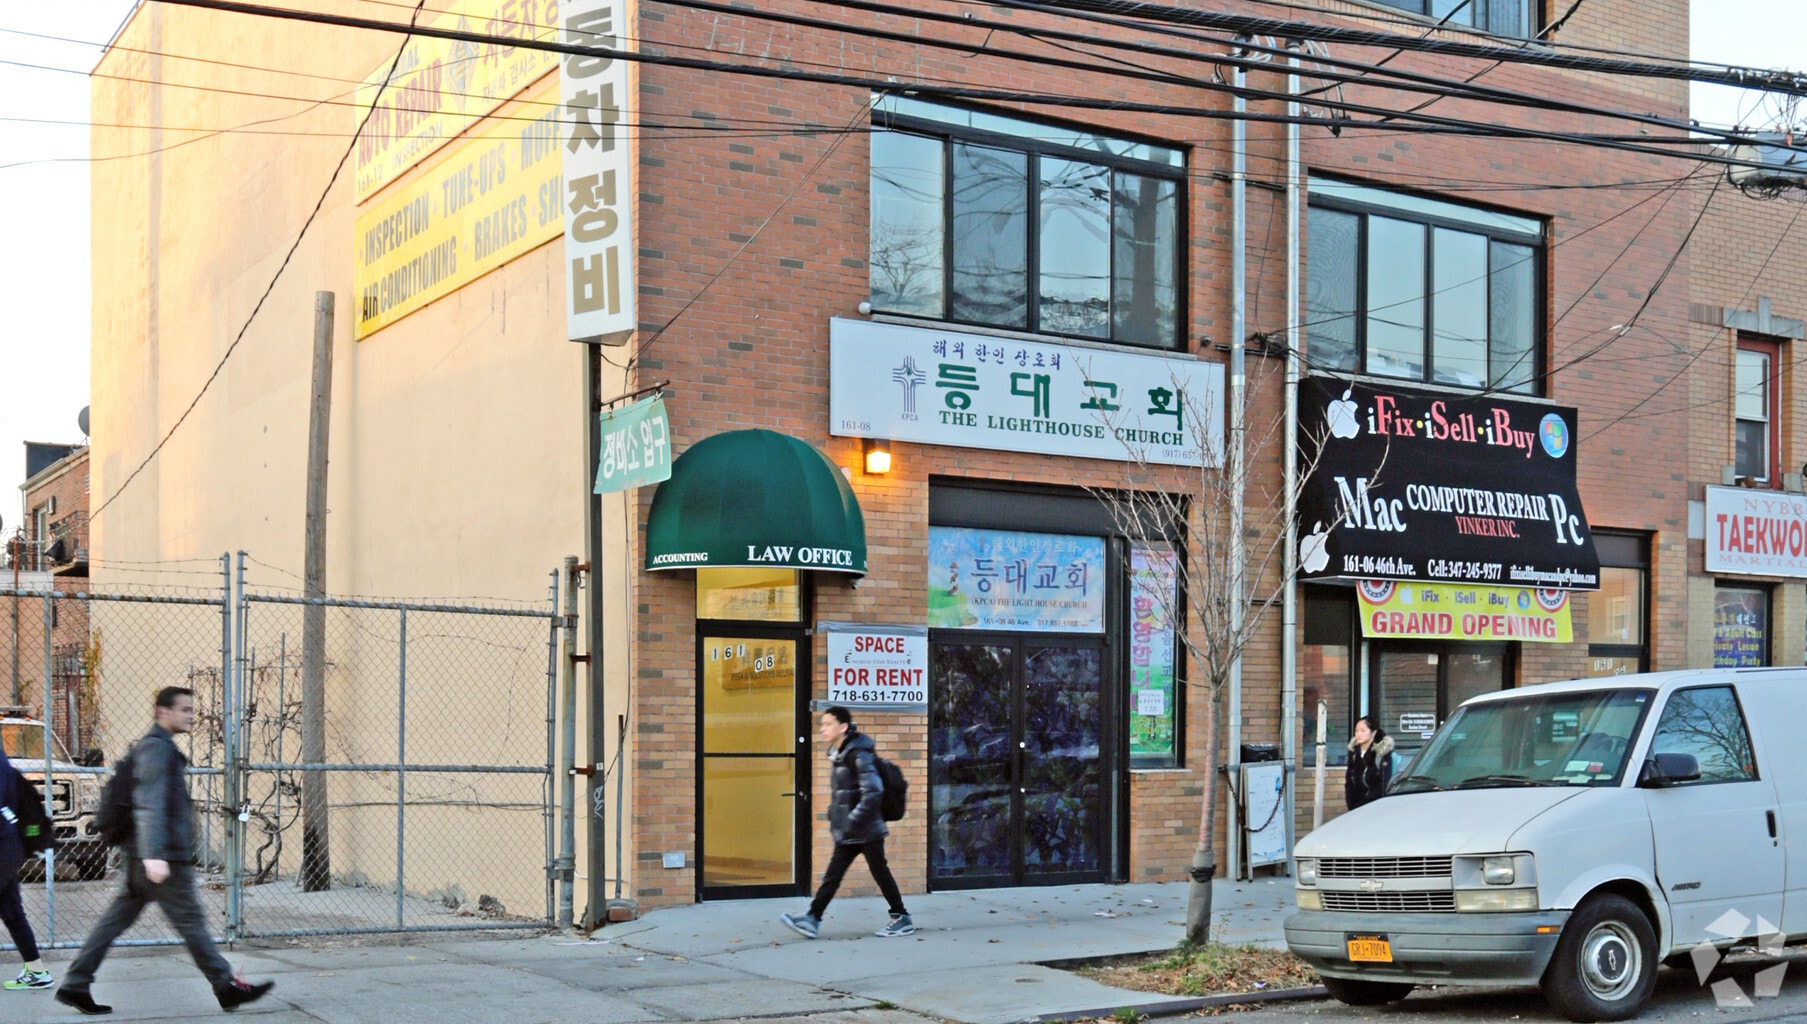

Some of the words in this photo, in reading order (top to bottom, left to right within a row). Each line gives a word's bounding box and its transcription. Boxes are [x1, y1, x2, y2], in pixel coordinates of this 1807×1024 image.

[358, 98, 391, 171] AUTO
[395, 57, 443, 143] REPAIR
[365, 192, 429, 267] INSPECTION
[443, 143, 506, 218] TUNE-UPS
[363, 281, 379, 322] AIR
[380, 235, 457, 313] CONDITIONING
[475, 194, 527, 262] BRAKES
[840, 420, 871, 431] 161-08
[901, 413, 919, 421] KPCA
[939, 410, 977, 427] THE
[987, 415, 1105, 440] LIGHTHOUSE
[1114, 427, 1184, 447] CHURCH
[1334, 476, 1407, 532] Mac
[1406, 483, 1494, 516] COMPUTER
[1496, 491, 1549, 521] REPAIR
[1455, 516, 1497, 537] YINKER
[1499, 519, 1520, 538] INC.
[1716, 513, 1807, 558] TAEKWO
[653, 552, 709, 564] ACCOUNTING
[747, 545, 794, 563] LAW
[797, 546, 853, 566] OFFICE
[1343, 554, 1375, 574] 161-06
[1375, 556, 1396, 575] 46th
[1396, 559, 1416, 576] Ave.
[970, 558, 1089, 597] 등대교회
[1427, 558, 1448, 577] Cell:
[972, 597, 996, 606] (KPCA)
[997, 598, 1010, 607] THE
[1012, 598, 1034, 607] LIGHT
[1035, 599, 1057, 608] HOUSE
[1059, 600, 1087, 609] CHURCH
[1421, 589, 1440, 603] iFix
[1454, 591, 1476, 605] iSell
[1488, 593, 1509, 608] iBuy
[1371, 610, 1453, 635] GRAND
[1462, 613, 1556, 638] OPENING
[855, 636, 905, 653] SPACE
[833, 668, 870, 686] FOR
[876, 668, 923, 687] RENT
[832, 690, 924, 702] 718-631-7700
